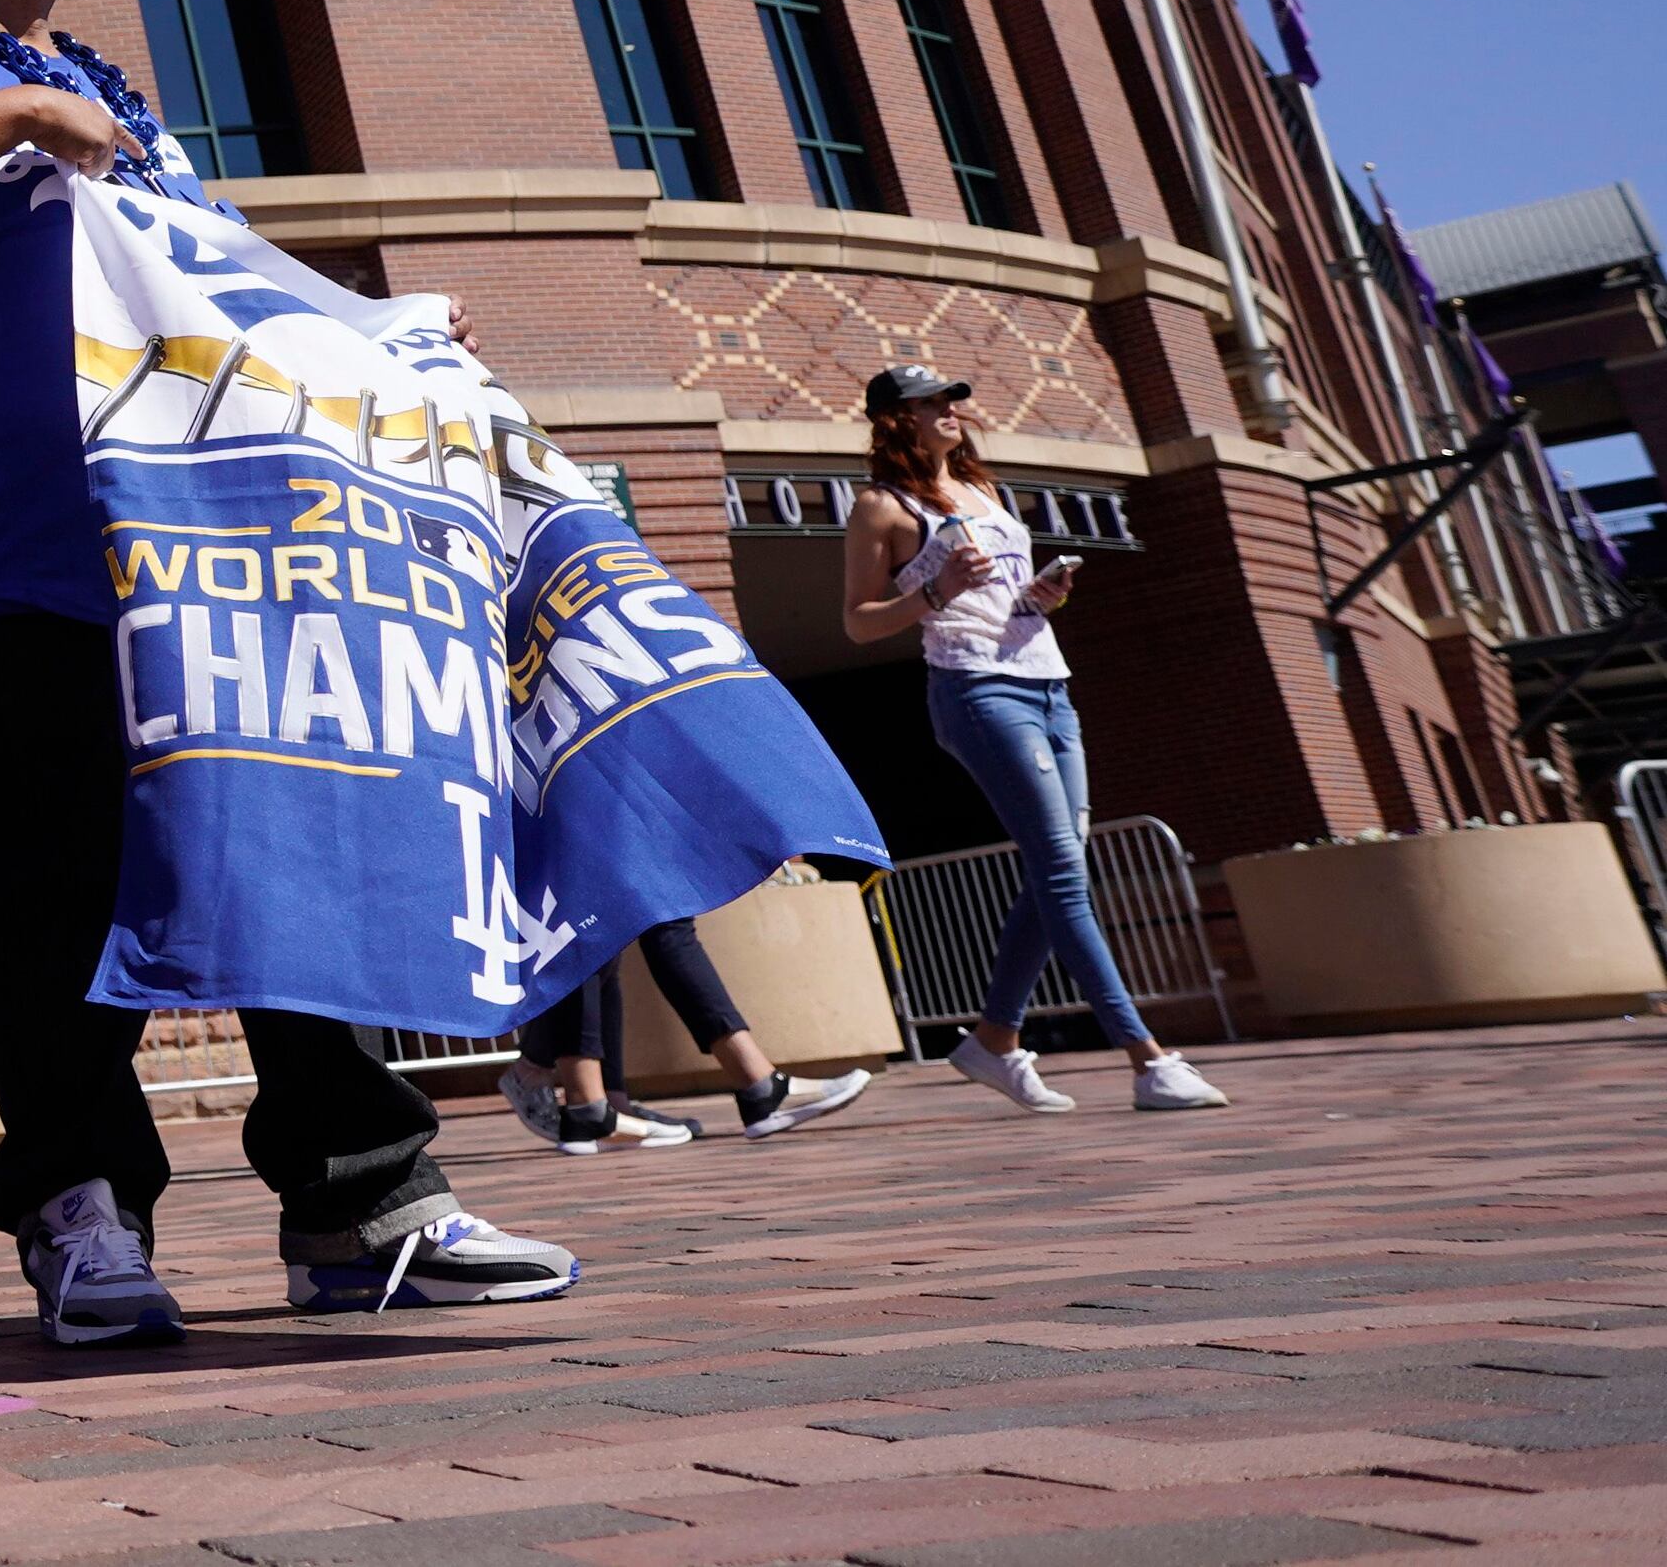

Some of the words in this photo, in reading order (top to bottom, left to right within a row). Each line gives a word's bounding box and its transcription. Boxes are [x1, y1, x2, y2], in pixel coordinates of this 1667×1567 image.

[724, 476, 855, 530] HOM
[105, 539, 466, 631] WORLD
[443, 780, 578, 1005] LA
[579, 913, 599, 930] TM
